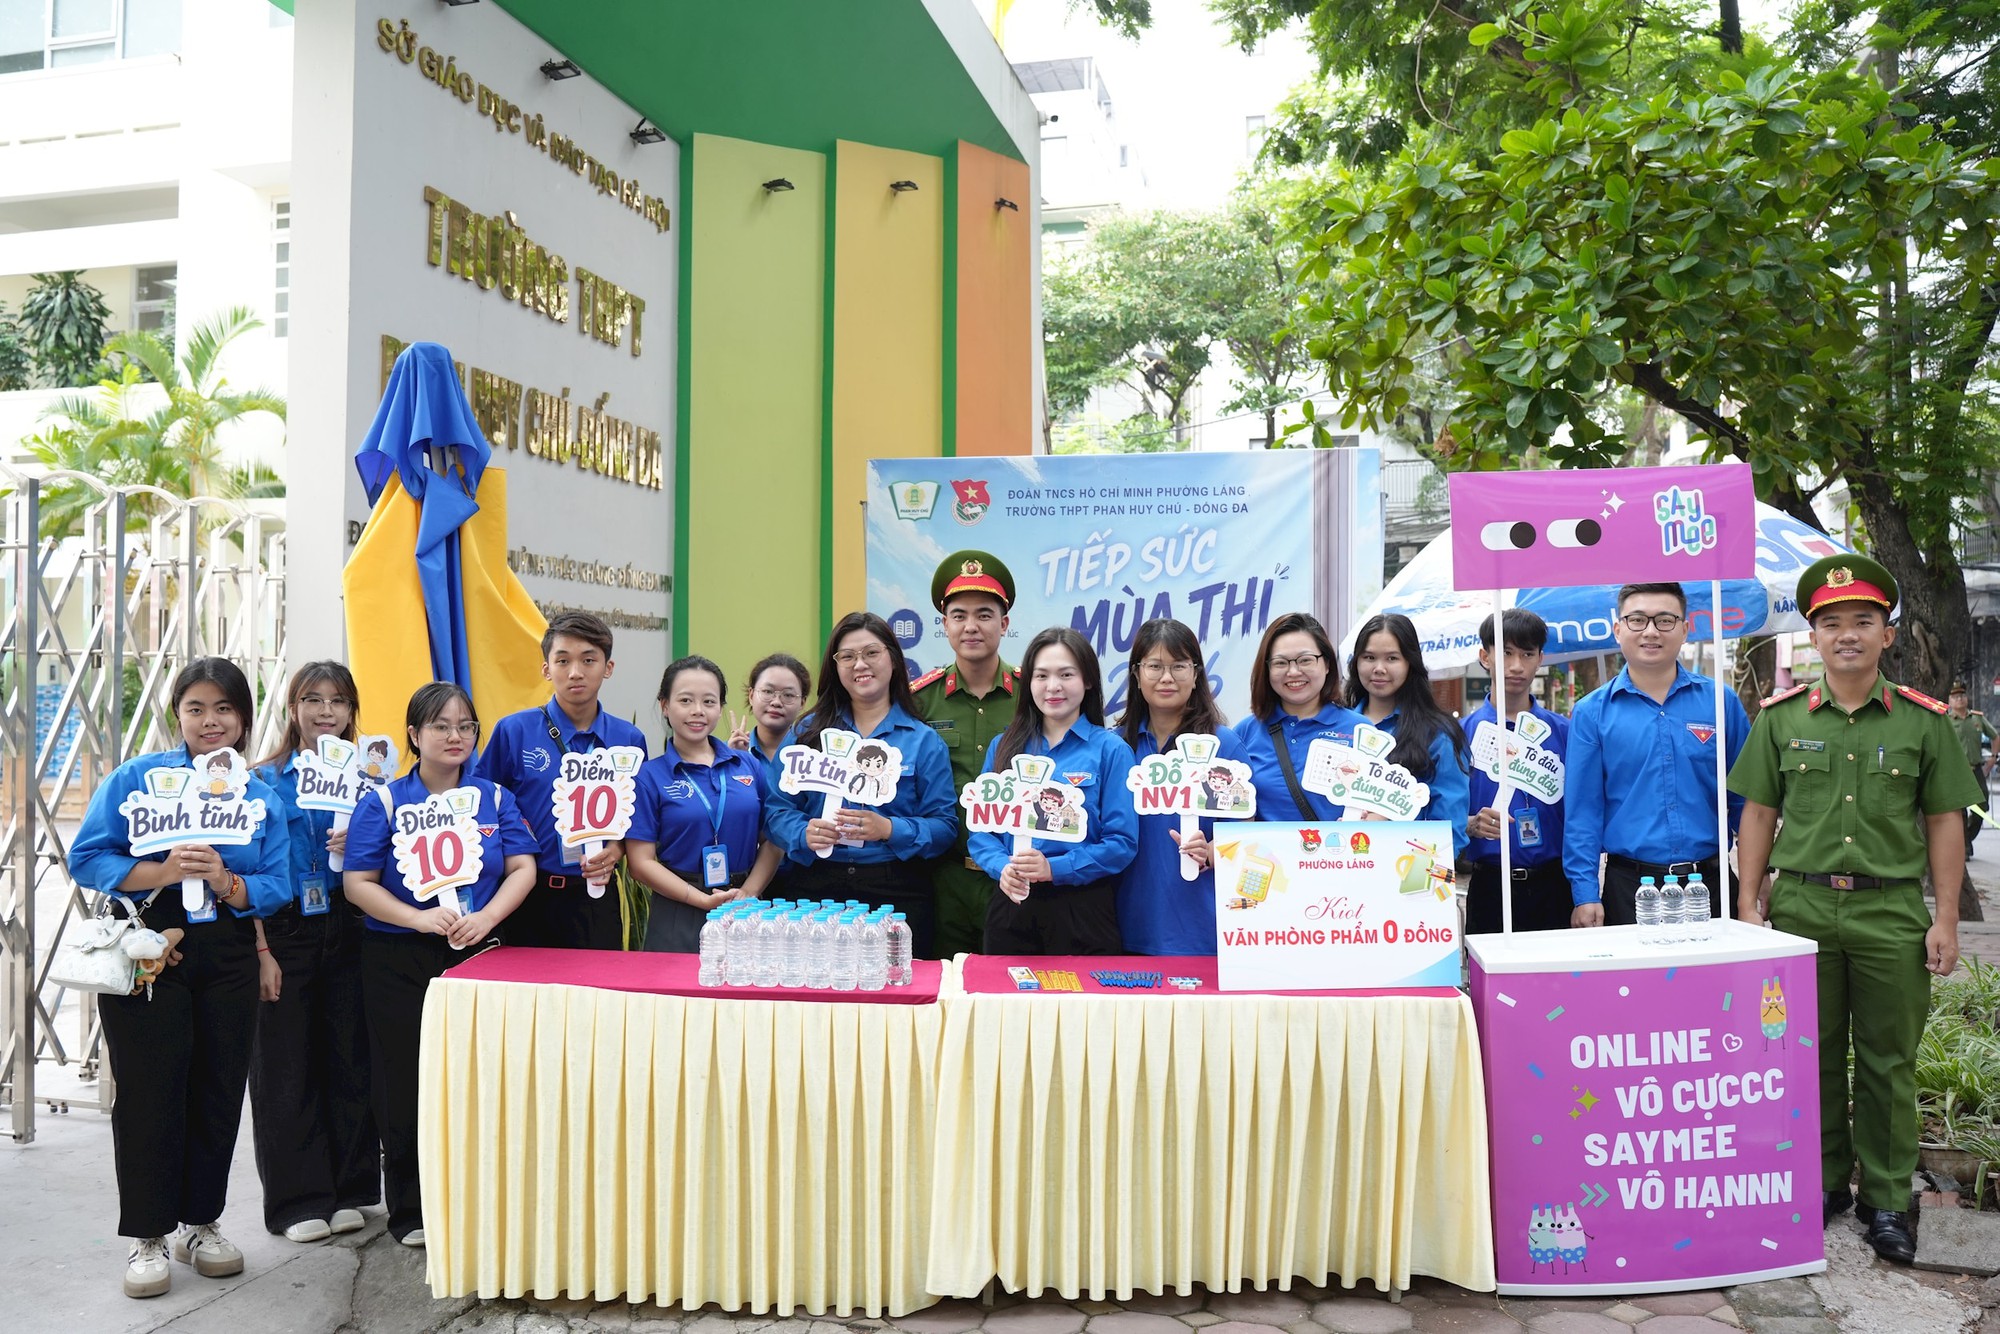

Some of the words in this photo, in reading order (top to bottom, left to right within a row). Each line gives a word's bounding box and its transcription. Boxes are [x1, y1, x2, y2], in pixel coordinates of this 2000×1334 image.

[377, 17, 418, 64] SỞ
[418, 46, 476, 103] GIÁO
[477, 82, 522, 132] DỤC
[524, 113, 548, 152] VÀ
[587, 156, 618, 197] TẠO
[619, 179, 642, 214] HÀ
[643, 195, 670, 234] NỘI
[424, 186, 569, 324] TRƯỜNG
[576, 267, 645, 357] THPT
[1008, 488, 1041, 499] ĐOÀN
[1045, 489, 1075, 499] TNCS
[1100, 486, 1119, 498] CHÍ
[1124, 488, 1152, 498] MINH
[1157, 485, 1209, 497] PHƯỜNG
[1213, 484, 1245, 496] LÁNG
[1006, 504, 1056, 517] TRƯỜNG
[1060, 506, 1089, 516] THPT
[1093, 505, 1125, 515] PHAN
[1129, 504, 1153, 515] HUY
[1157, 502, 1181, 514] CHÚ
[1194, 502, 1228, 514] ĐỐNG
[1232, 503, 1249, 513] ĐA
[1038, 528, 1131, 597] TIẾP
[1139, 523, 1217, 583] SỨC
[1188, 576, 1274, 645] THI
[1773, 598, 1799, 614] NÂN
[1419, 634, 1451, 653] TRẢI
[1453, 634, 1483, 649] NGH
[565, 754, 615, 782] Điểm
[786, 751, 814, 779] Tự
[819, 757, 847, 784] tin
[1149, 758, 1184, 785] Đỗ
[1369, 762, 1383, 778] Tô
[1385, 769, 1410, 790] đâu
[1524, 746, 1538, 761] Tô
[1538, 755, 1559, 774] đâu
[301, 767, 348, 799] Bình
[981, 776, 1017, 803] Đỗ
[1508, 757, 1537, 782] đúng
[1538, 773, 1559, 797] đấy
[568, 785, 617, 832] 10
[1142, 786, 1191, 809] NV1
[1351, 776, 1385, 802] đúng
[1387, 790, 1413, 816] đấy
[131, 802, 191, 838] Bình
[200, 803, 248, 830] tĩnh
[401, 801, 455, 835] Điểm
[973, 803, 1023, 827] NV1
[411, 830, 464, 885] 10
[1299, 858, 1344, 870] PHƯỜNG
[1347, 858, 1375, 869] LÁNG
[1304, 896, 1365, 920] Kiot
[1223, 928, 1259, 946] VĂN
[1265, 927, 1325, 946] PHÒNG
[1331, 921, 1378, 944] PHẨM
[1383, 920, 1398, 944] 0
[1404, 921, 1453, 943] ĐỒNG
[1570, 1028, 1712, 1069] ONLINE
[1615, 1076, 1664, 1118] VÔ
[1672, 1068, 1785, 1121] CỰCCC
[1584, 1125, 1737, 1167] SAYMEE
[1617, 1169, 1665, 1210] VÔ
[1675, 1171, 1793, 1219] HẠNNN
